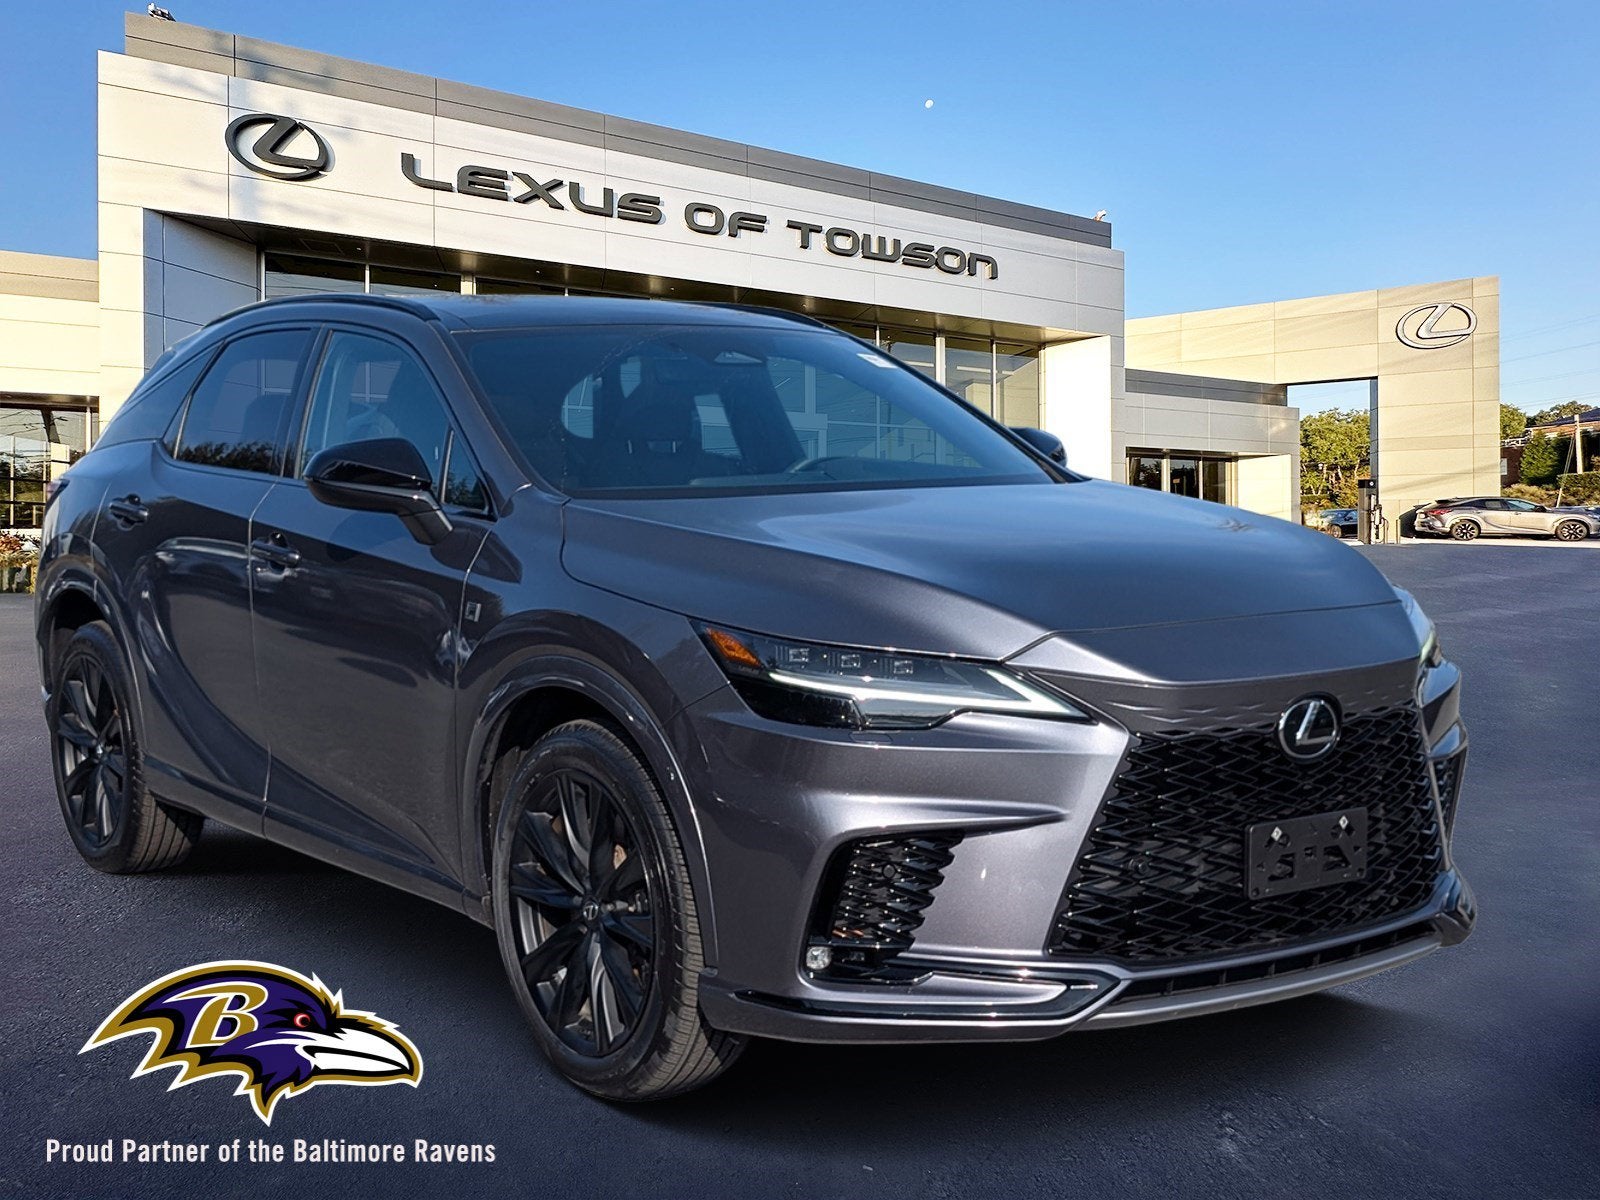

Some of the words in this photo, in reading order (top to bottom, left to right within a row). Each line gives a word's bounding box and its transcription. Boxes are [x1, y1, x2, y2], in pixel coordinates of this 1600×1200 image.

[400, 152, 664, 225] LEXUS
[685, 202, 767, 238] OF
[787, 219, 999, 280] TOWSON
